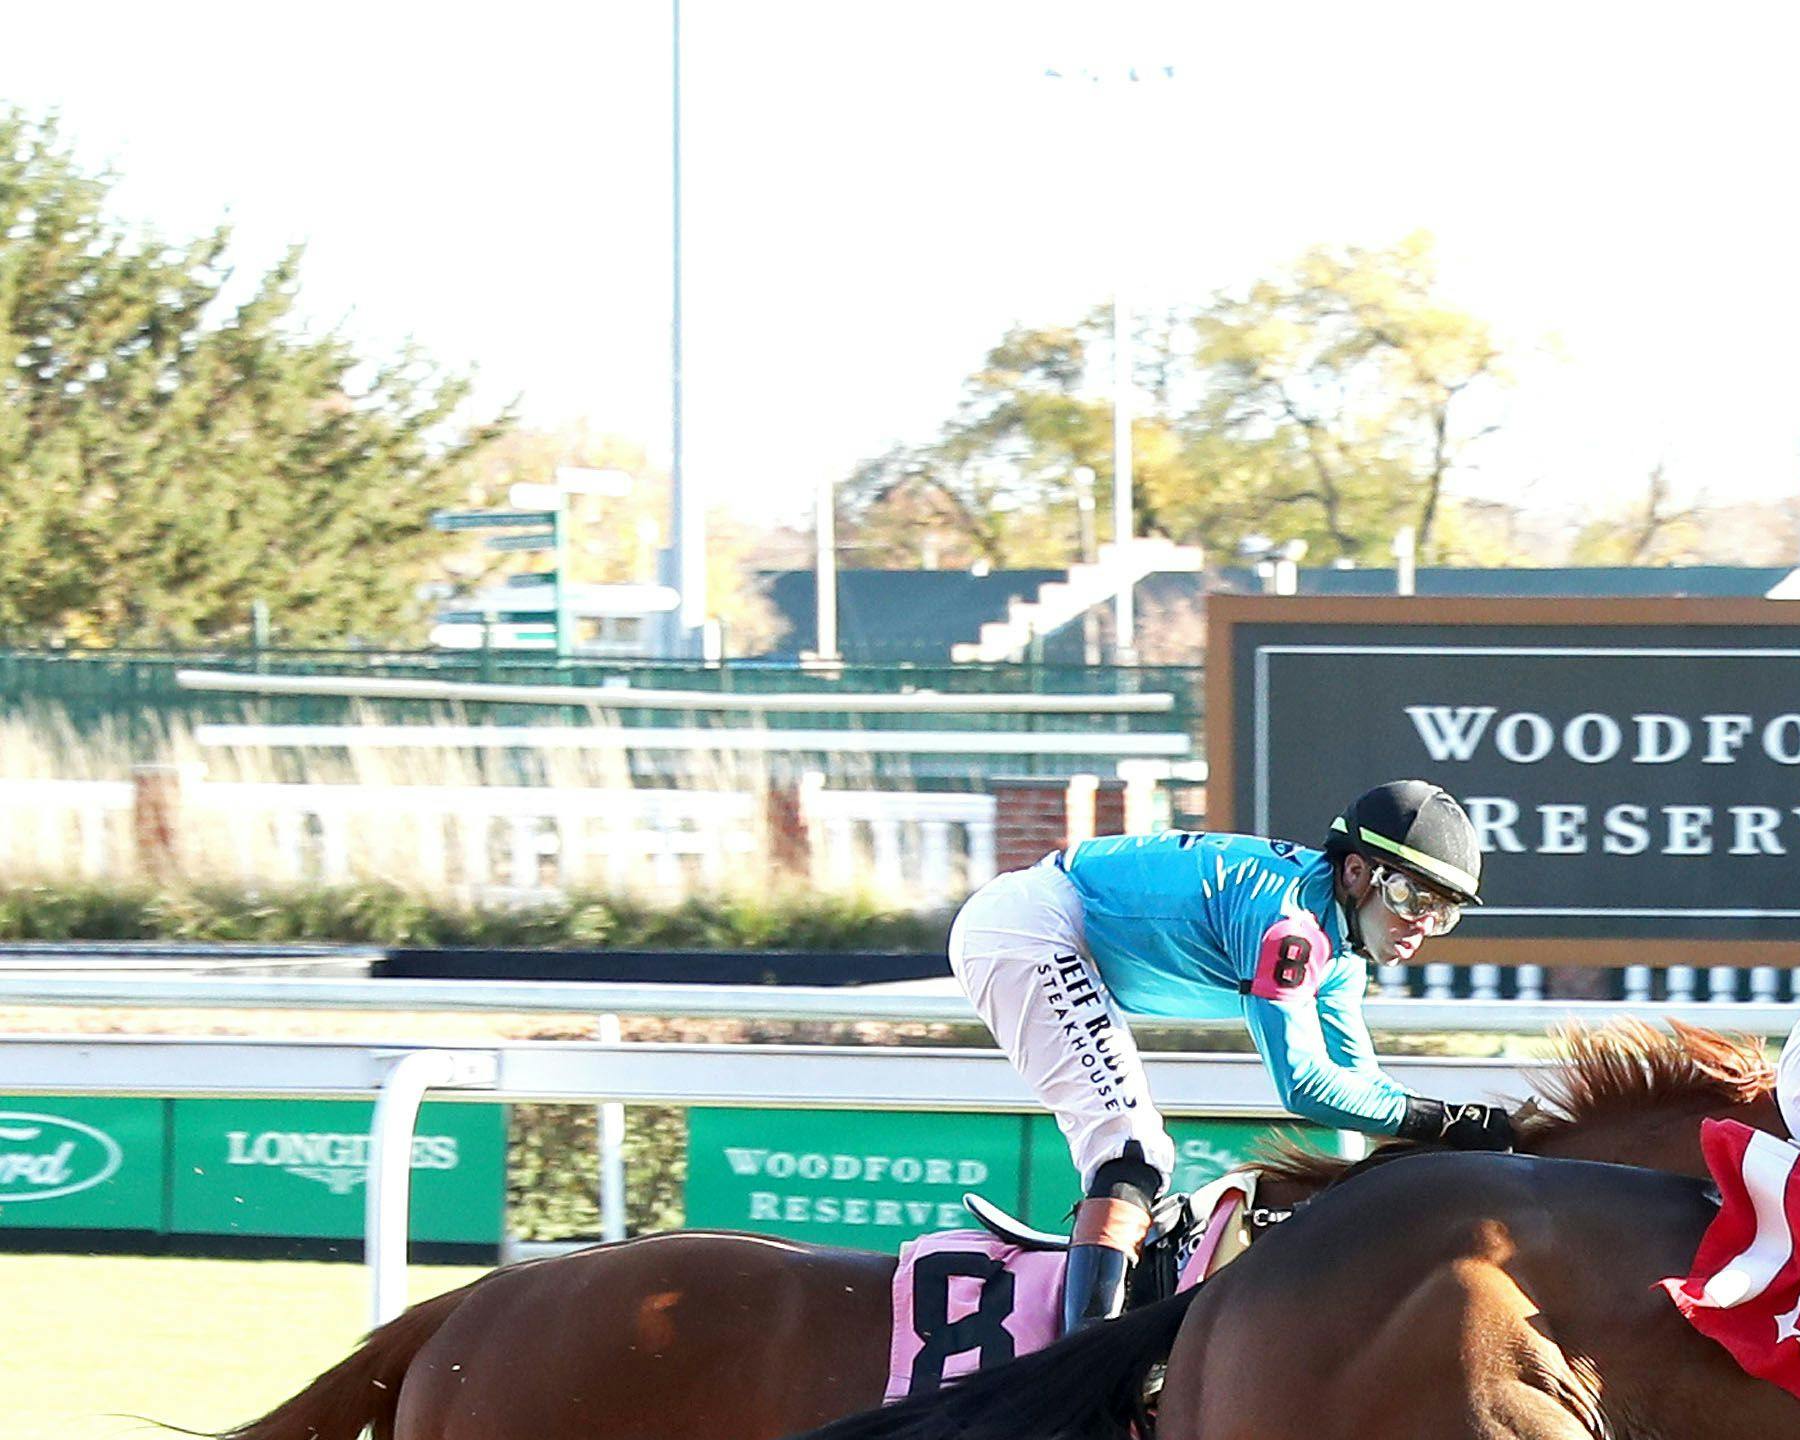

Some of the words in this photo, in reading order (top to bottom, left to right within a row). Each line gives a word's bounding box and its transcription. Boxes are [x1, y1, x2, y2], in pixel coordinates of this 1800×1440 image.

[1053, 952, 1101, 1008] JEFF
[1275, 935, 1312, 989] 8
[1037, 963, 1120, 1113] STEAKHOUSE
[226, 1131, 459, 1170] LONGIES
[724, 1147, 989, 1186] WOODFORD
[749, 1190, 965, 1228] RESERVE
[907, 1251, 1016, 1396] 8
